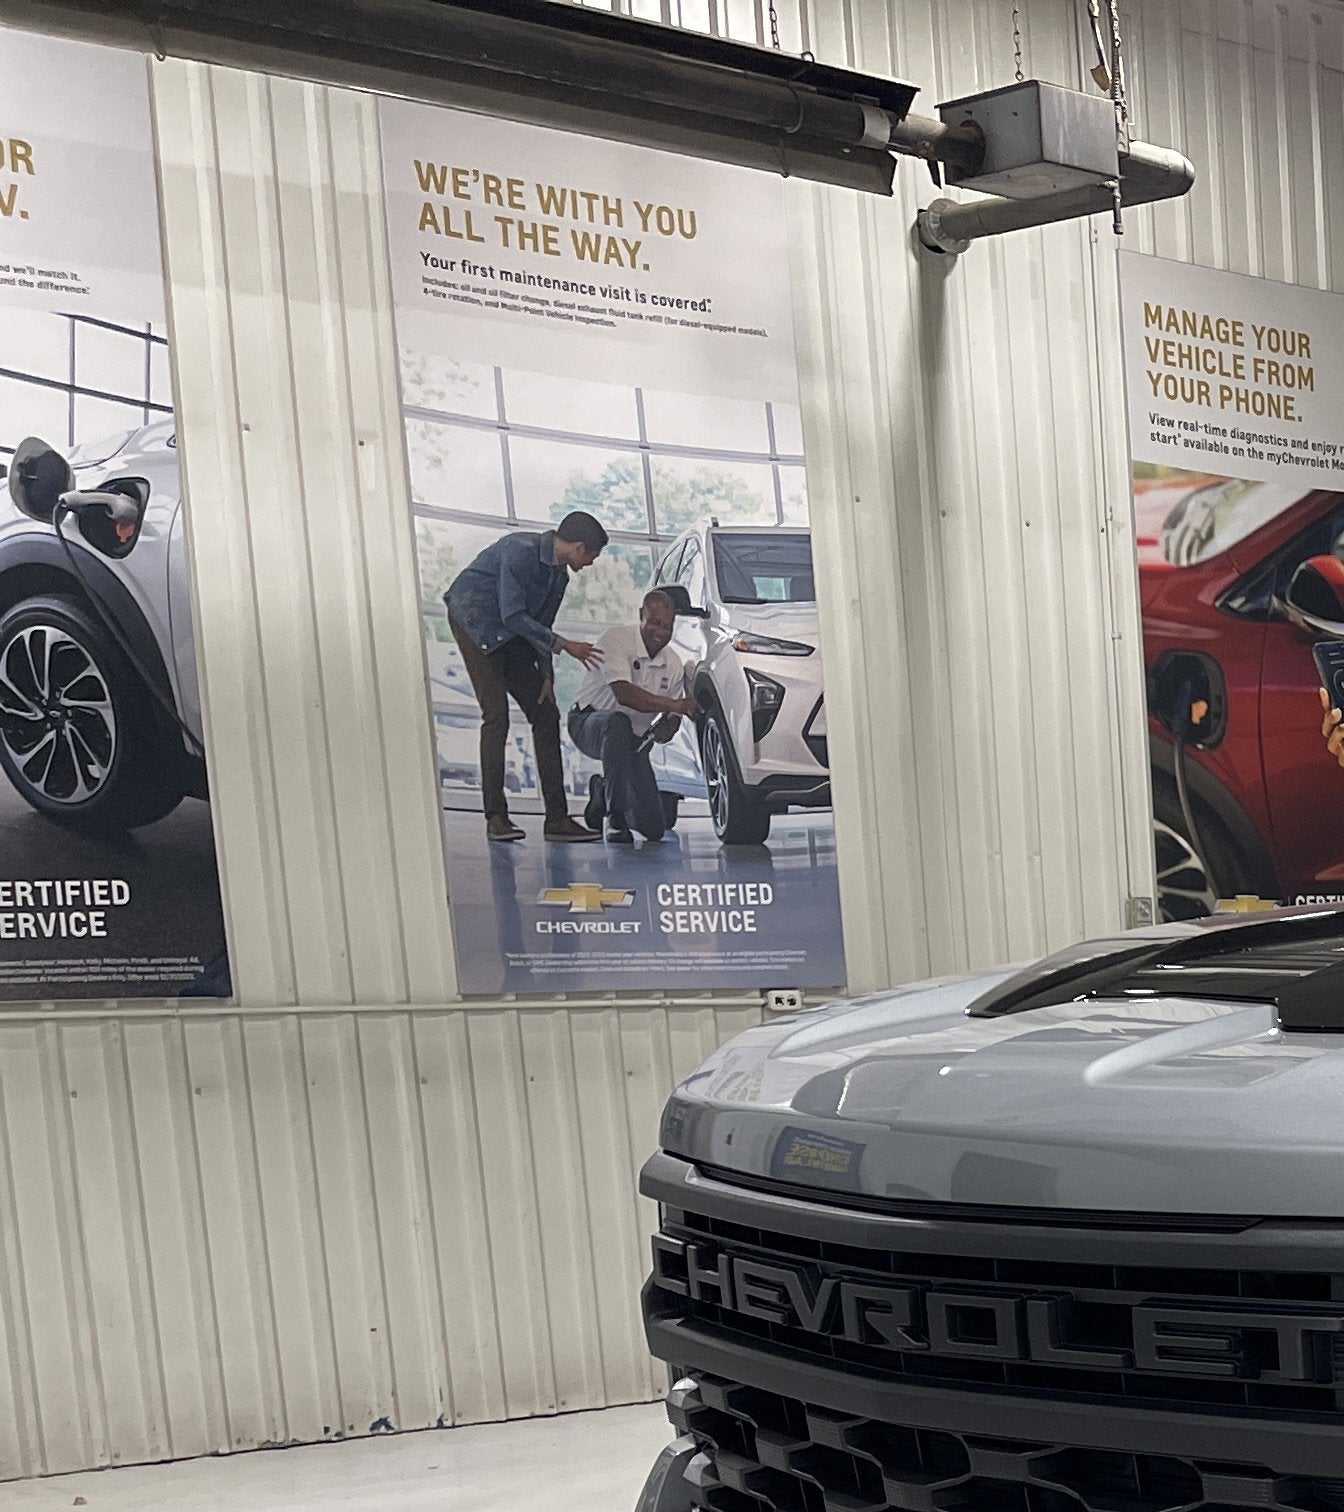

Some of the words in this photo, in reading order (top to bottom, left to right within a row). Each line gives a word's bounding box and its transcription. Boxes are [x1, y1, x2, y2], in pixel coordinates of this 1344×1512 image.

[413, 160, 526, 211] WE'RE
[535, 183, 623, 228] WITH
[632, 200, 697, 240] YOU
[419, 202, 485, 243] ALL
[494, 216, 561, 256] THE
[570, 229, 650, 272] WAY.
[420, 251, 456, 273] Your
[461, 260, 495, 280] first
[500, 269, 596, 297] maintenance
[600, 285, 631, 302] visit
[634, 288, 647, 304] is
[1143, 302, 1245, 348] MANAGE
[1251, 324, 1312, 359] YOUR
[1144, 336, 1246, 381] VEHICLE
[1253, 358, 1315, 392] FROM
[1146, 370, 1212, 407] YOUR
[1219, 384, 1303, 423] PHONE.
[1148, 412, 1175, 429] View
[1178, 418, 1228, 438] real-time
[1230, 427, 1288, 448] diagnostics
[1290, 438, 1309, 450] and
[1311, 441, 1338, 457] enjoy
[1183, 437, 1230, 455] available
[1232, 445, 1245, 457] on
[1247, 446, 1264, 460] the
[1267, 449, 1329, 469] myChevrolet
[657, 883, 773, 907] CERTIFIED
[535, 921, 642, 935] CHEVROLET
[659, 910, 757, 934] SERVICE
